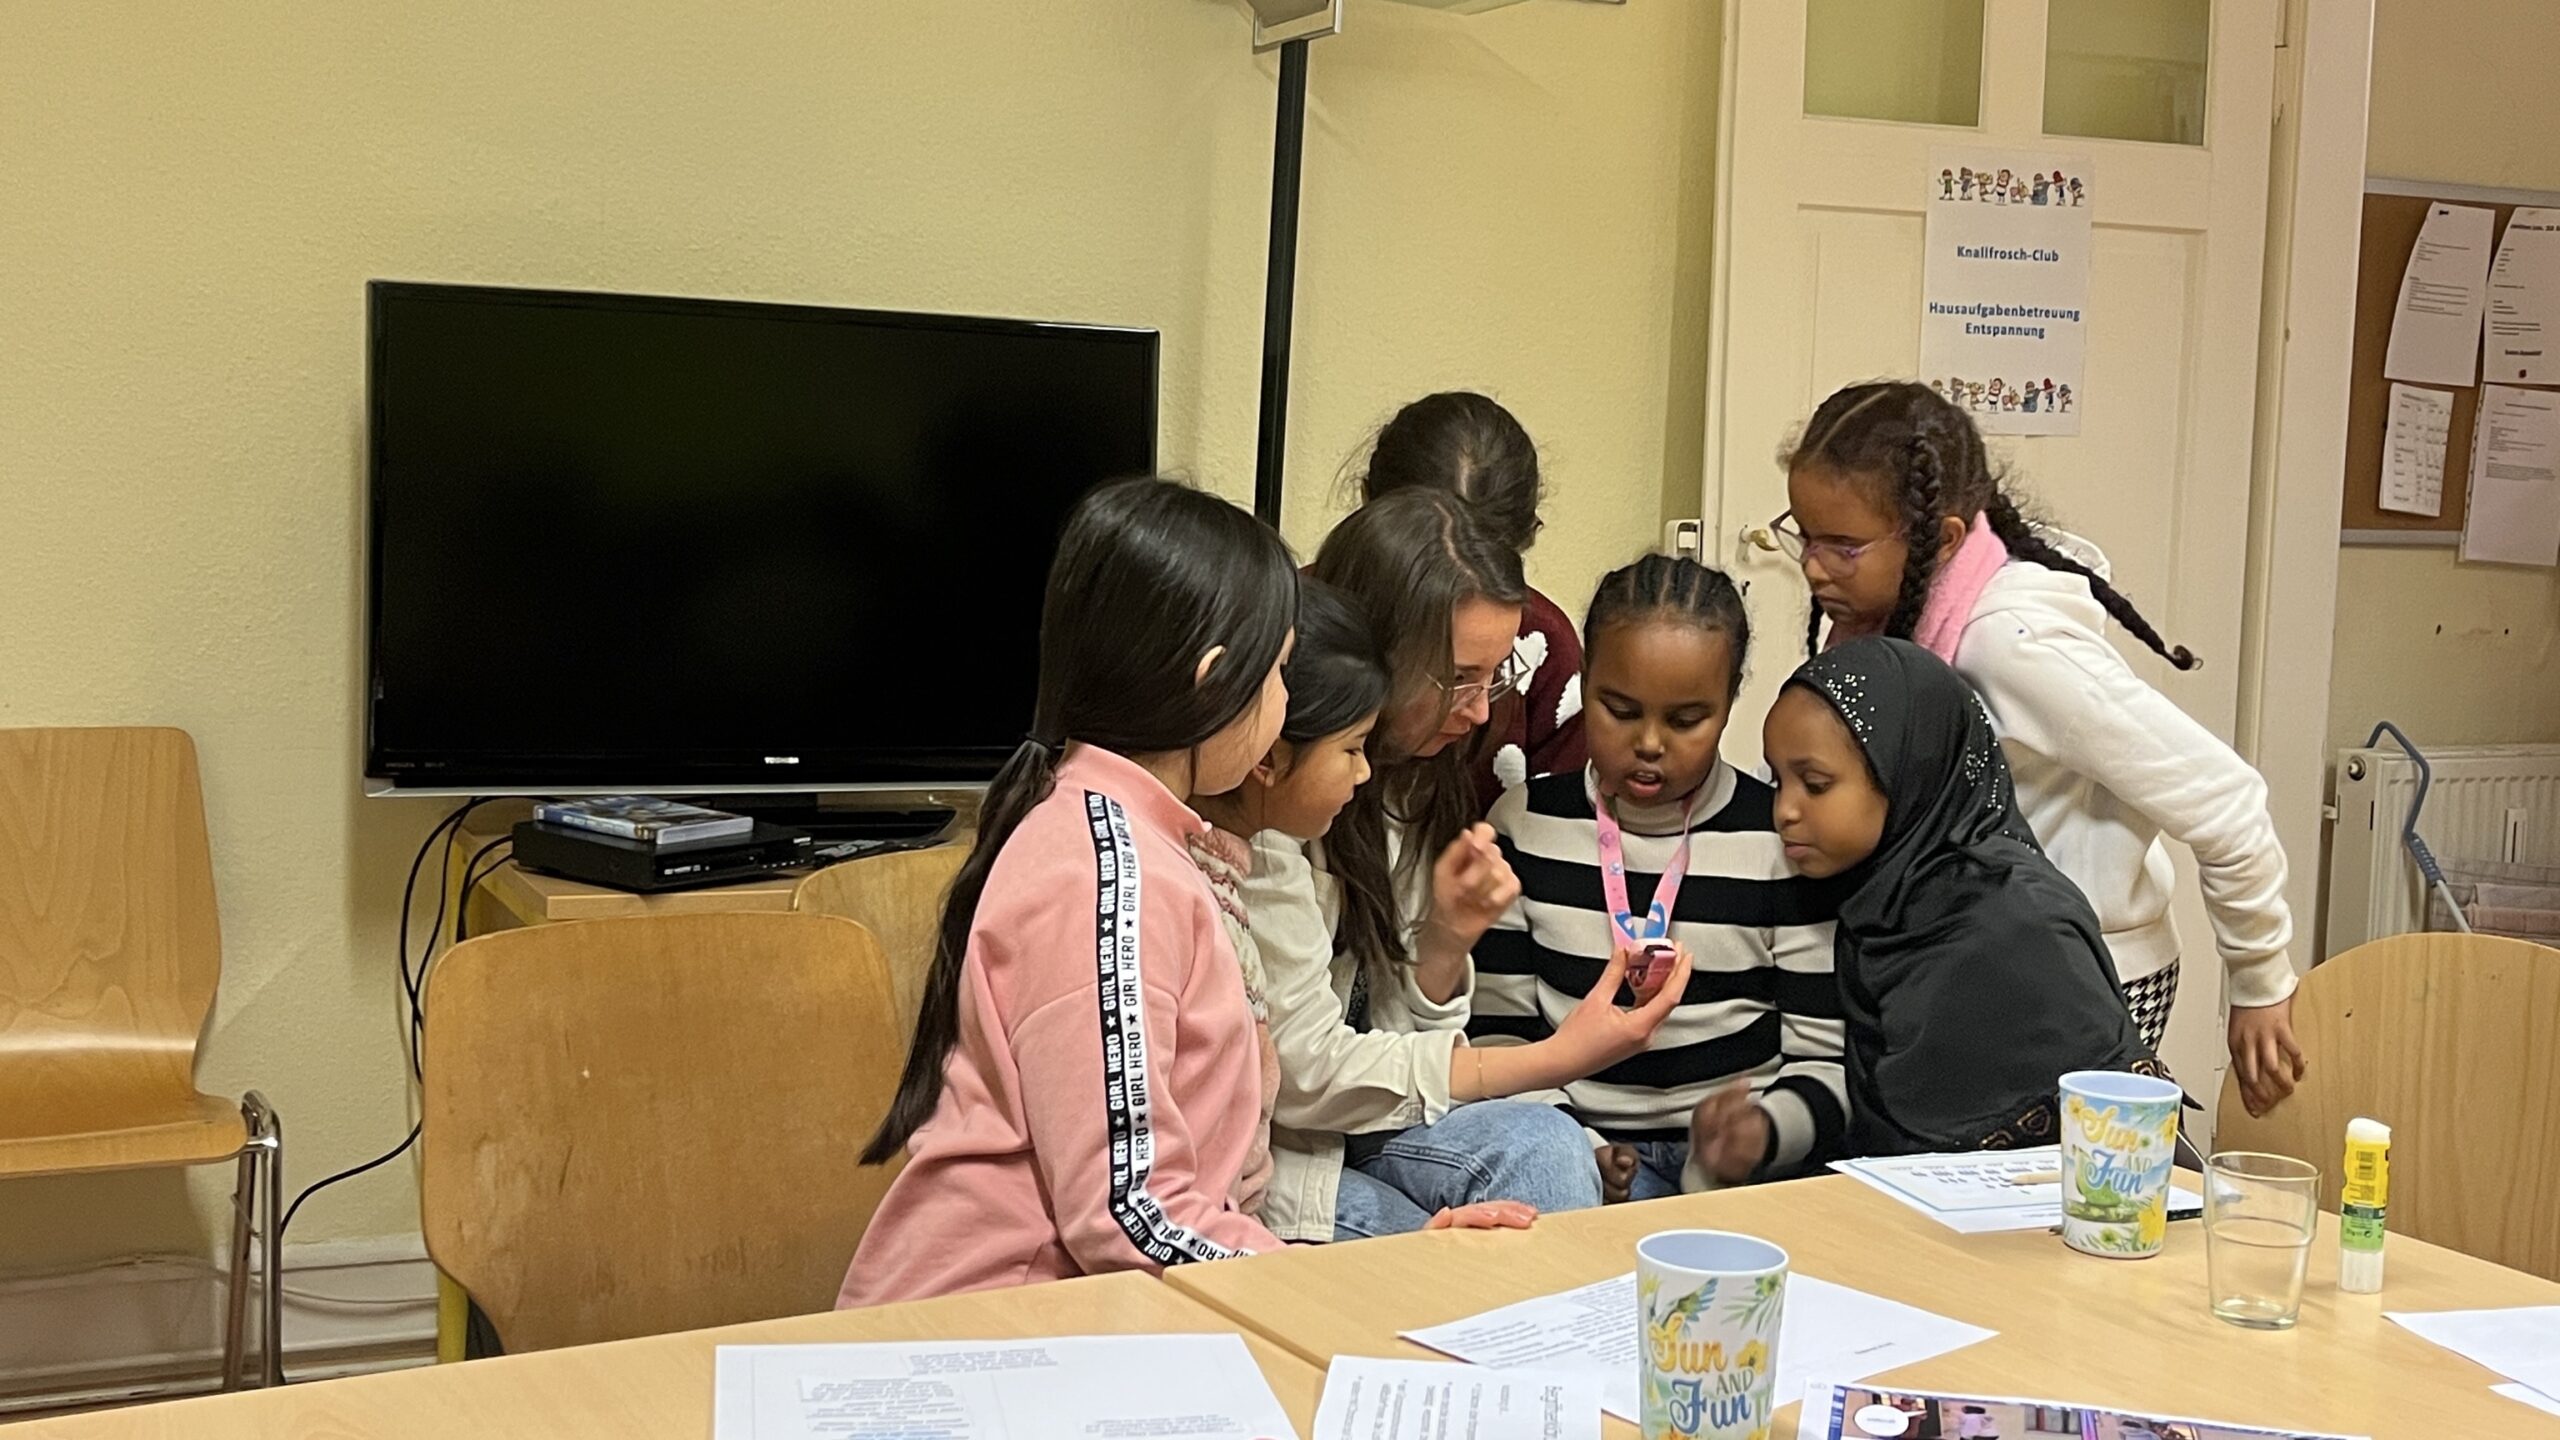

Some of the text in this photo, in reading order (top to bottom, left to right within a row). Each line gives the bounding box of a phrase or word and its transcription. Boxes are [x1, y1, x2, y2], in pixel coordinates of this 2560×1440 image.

[1957, 245, 2060, 262] Knallfrosch-Club
[1929, 301, 2080, 321] Hausaufgabenbetreuung
[1965, 322, 2045, 339] Entspannung
[1100, 850, 1116, 915] GIRL HERO
[1121, 851, 1137, 912] GIRL HERO
[1099, 935, 1116, 1011] GIRL HERO
[1121, 935, 1137, 1007] GIRL HERO
[1106, 1033, 1126, 1111] GIRL HERO
[1127, 1031, 1147, 1106] GIRL HERO
[1135, 1127, 1149, 1160] HERO
[2080, 1105, 2139, 1153] Sun
[1113, 1130, 1129, 1199] GIRL HERO
[2085, 1149, 2145, 1196] Fun
[2123, 1154, 2153, 1173] AND
[1144, 1238, 1173, 1262] GIRL
[1648, 1312, 1728, 1374] Sun
[1670, 1378, 1752, 1434] Fun
[1716, 1369, 1754, 1395] AND
